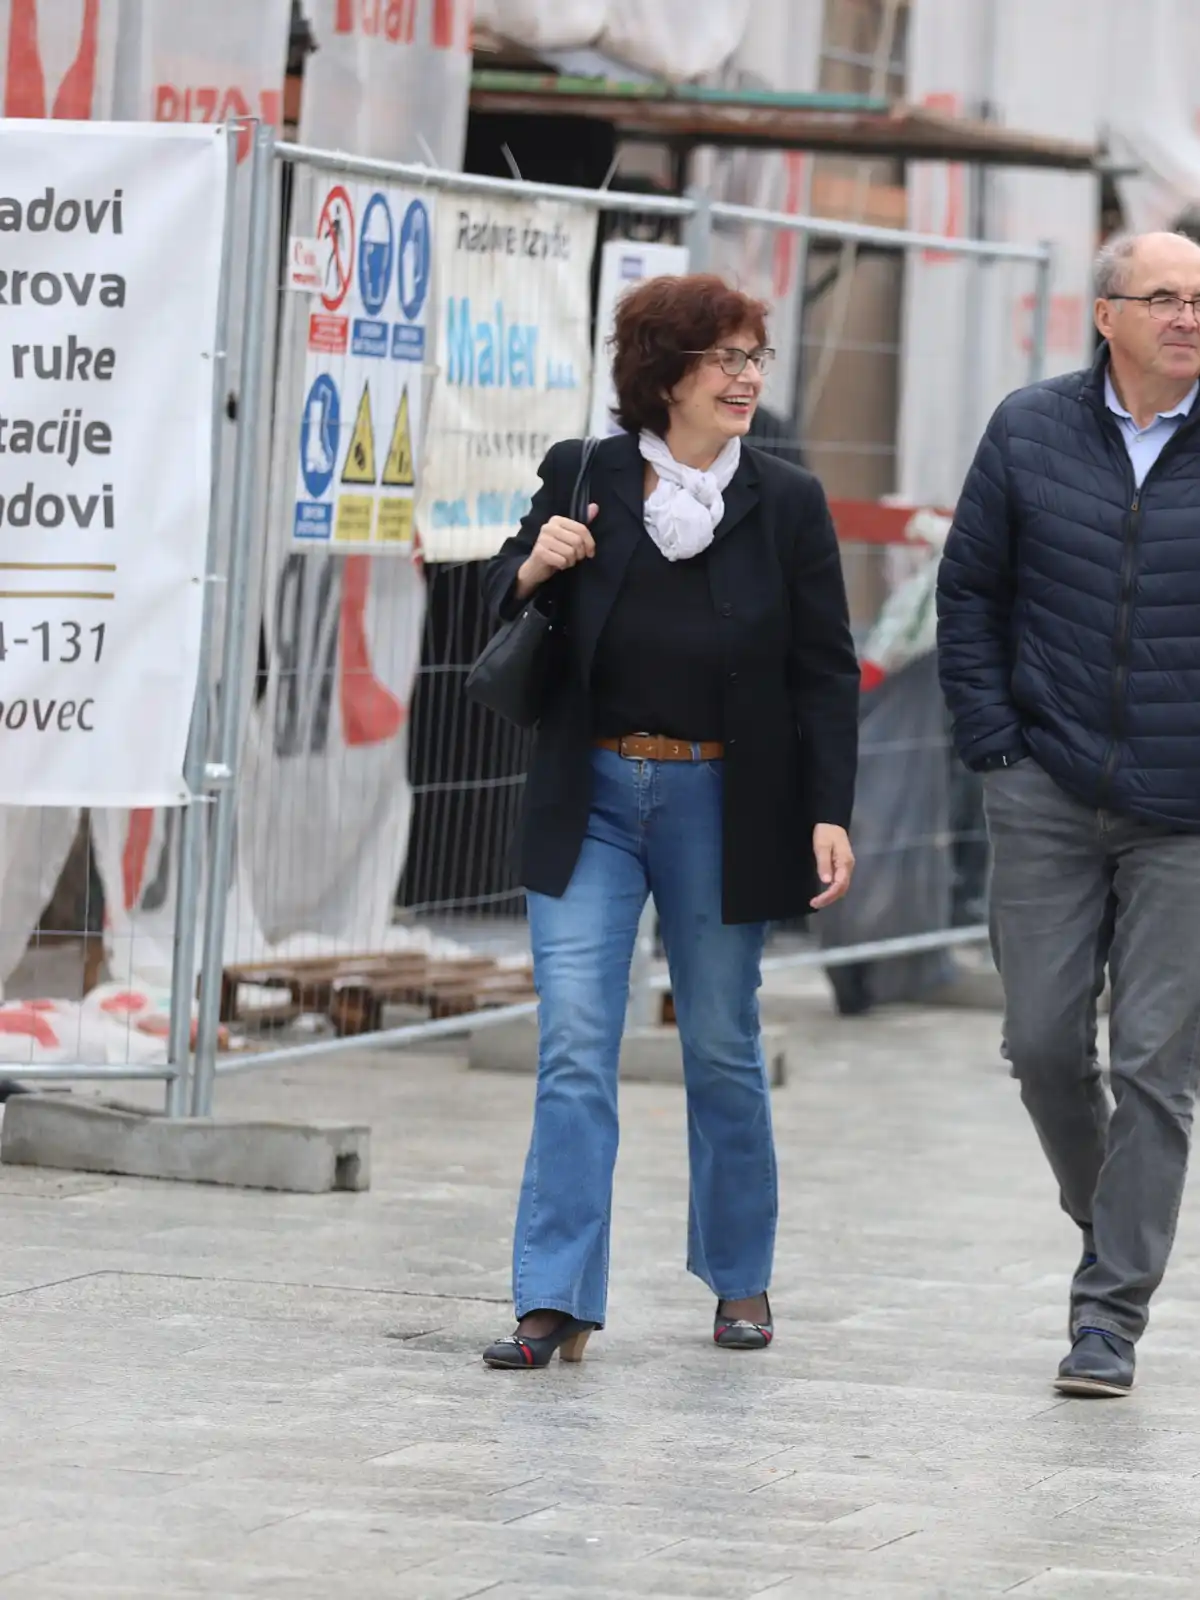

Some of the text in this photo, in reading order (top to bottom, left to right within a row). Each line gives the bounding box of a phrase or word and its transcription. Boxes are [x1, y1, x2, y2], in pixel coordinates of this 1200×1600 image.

[12, 335, 116, 382] ruke
[446, 297, 538, 388] Maler
[0, 482, 114, 529] dovi
[0, 697, 94, 732] ovec
